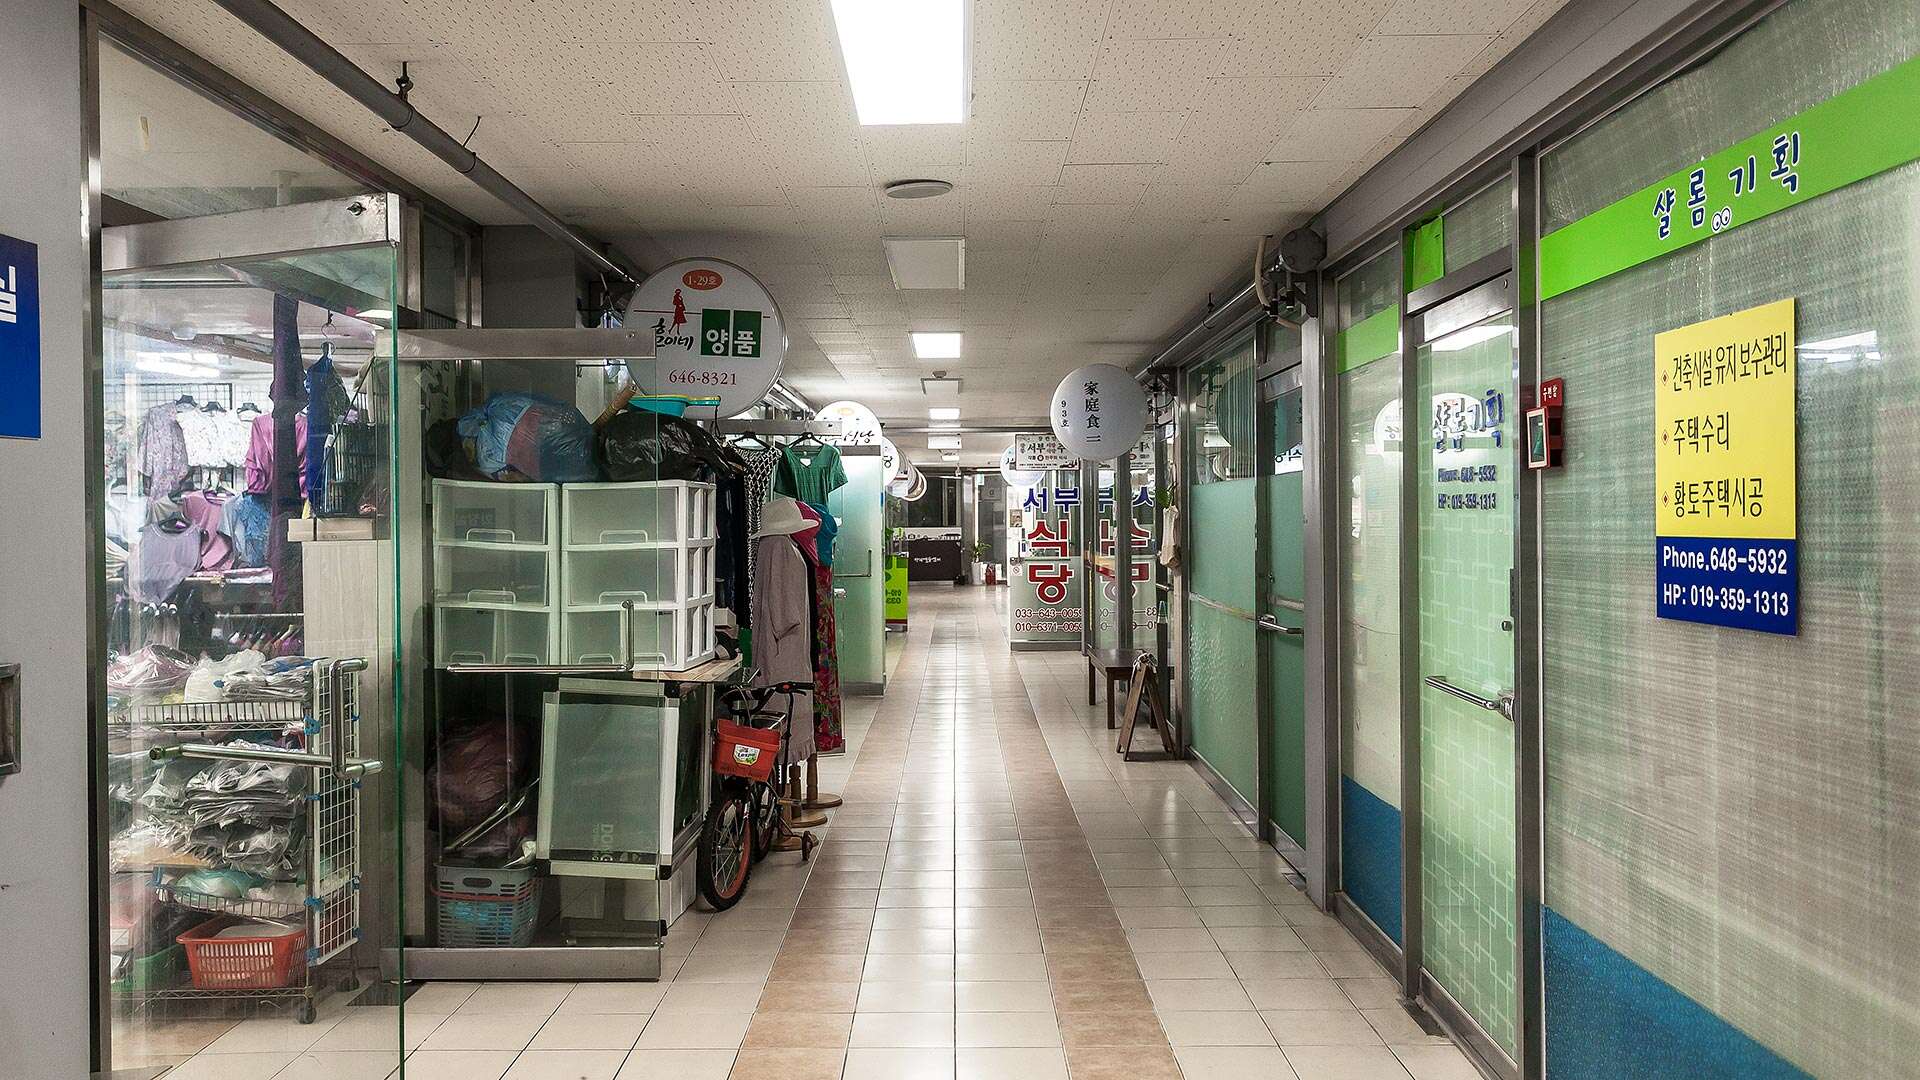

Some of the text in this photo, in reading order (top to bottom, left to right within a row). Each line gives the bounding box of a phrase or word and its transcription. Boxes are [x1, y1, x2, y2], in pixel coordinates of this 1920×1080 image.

[1653, 132, 1800, 240] 샬롬 기획
[706, 329, 757, 355] 양품
[669, 369, 737, 386] 646-8321
[1672, 349, 1712, 392] 건축시설
[1673, 411, 1729, 456] 주택수리
[1023, 487, 1080, 513] 서부
[1673, 478, 1764, 518] 황토주택시공
[1663, 583, 1789, 616] HP: 019-359-1313
